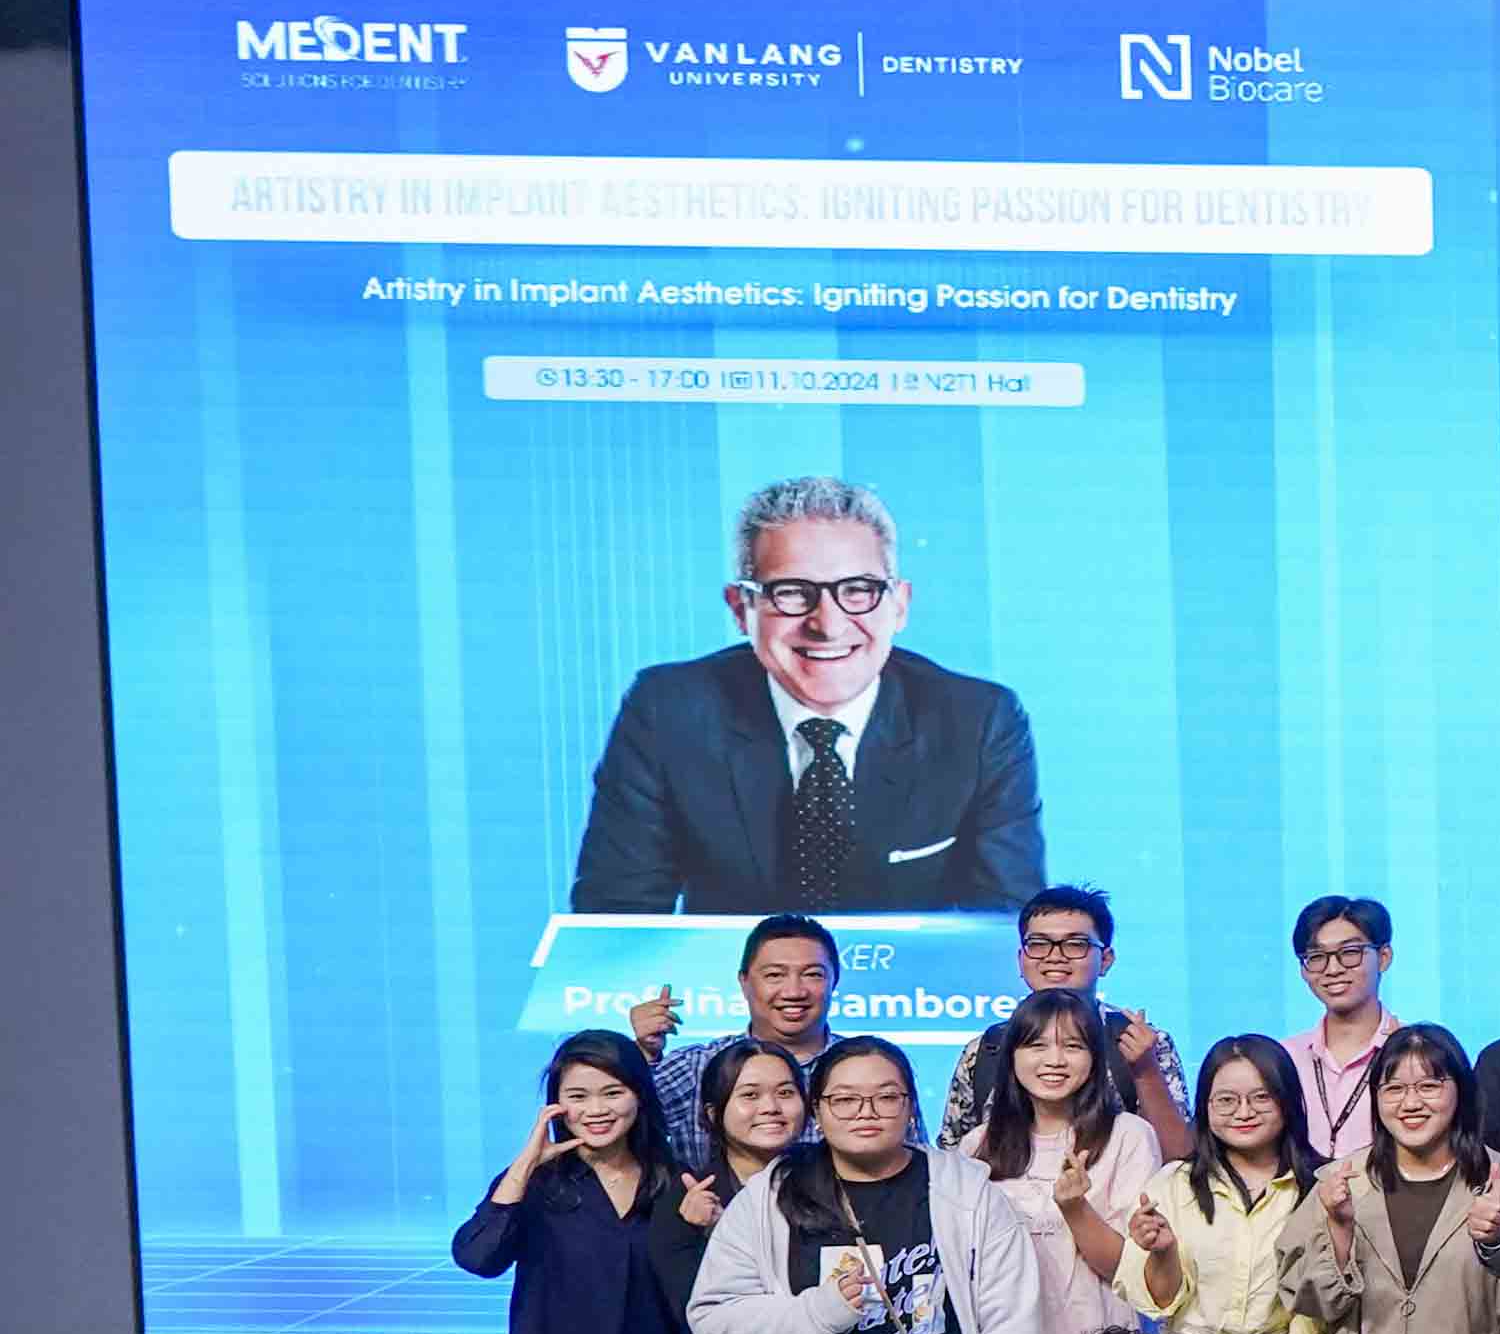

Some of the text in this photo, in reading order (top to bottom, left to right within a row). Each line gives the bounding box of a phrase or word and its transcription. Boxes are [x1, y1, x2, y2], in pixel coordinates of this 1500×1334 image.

[238, 16, 466, 63] MEDENT
[883, 57, 1022, 74] DENTISTRY
[1209, 46, 1303, 72] Nobel
[670, 72, 820, 86] UNIVERSITY
[1210, 75, 1322, 102] Biocare
[231, 172, 386, 215] ARTISTRY
[400, 178, 433, 216] IN
[970, 186, 1112, 224] PASSION
[1121, 187, 1183, 225] FOR
[363, 277, 1237, 315] Artistry in Implant Aesthetics: Igniting Passion for Dentistry
